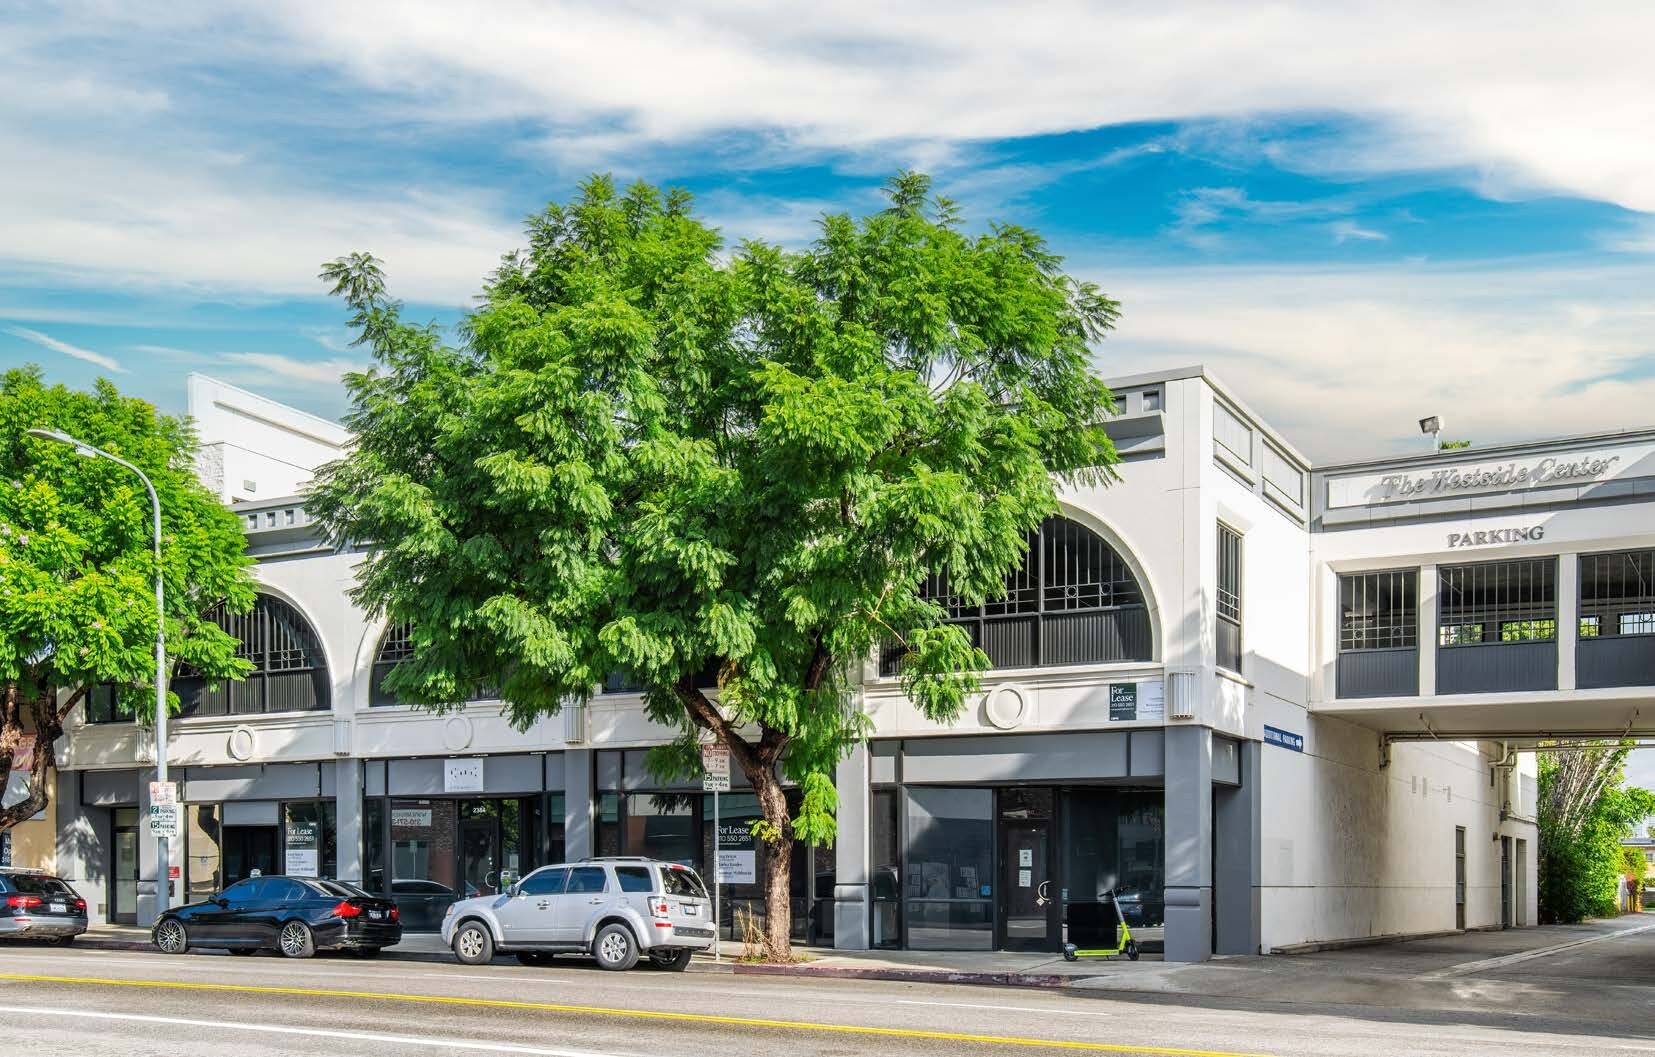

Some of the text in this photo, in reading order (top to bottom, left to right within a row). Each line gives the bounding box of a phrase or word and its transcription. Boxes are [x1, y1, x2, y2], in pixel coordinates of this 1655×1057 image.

[1380, 455, 1620, 497] The Westside Center
[1447, 525, 1545, 548] PARKING
[1111, 686, 1124, 695] For
[1111, 694, 1134, 702] Lease
[287, 827, 313, 835] For Lease
[729, 825, 749, 834] Lease
